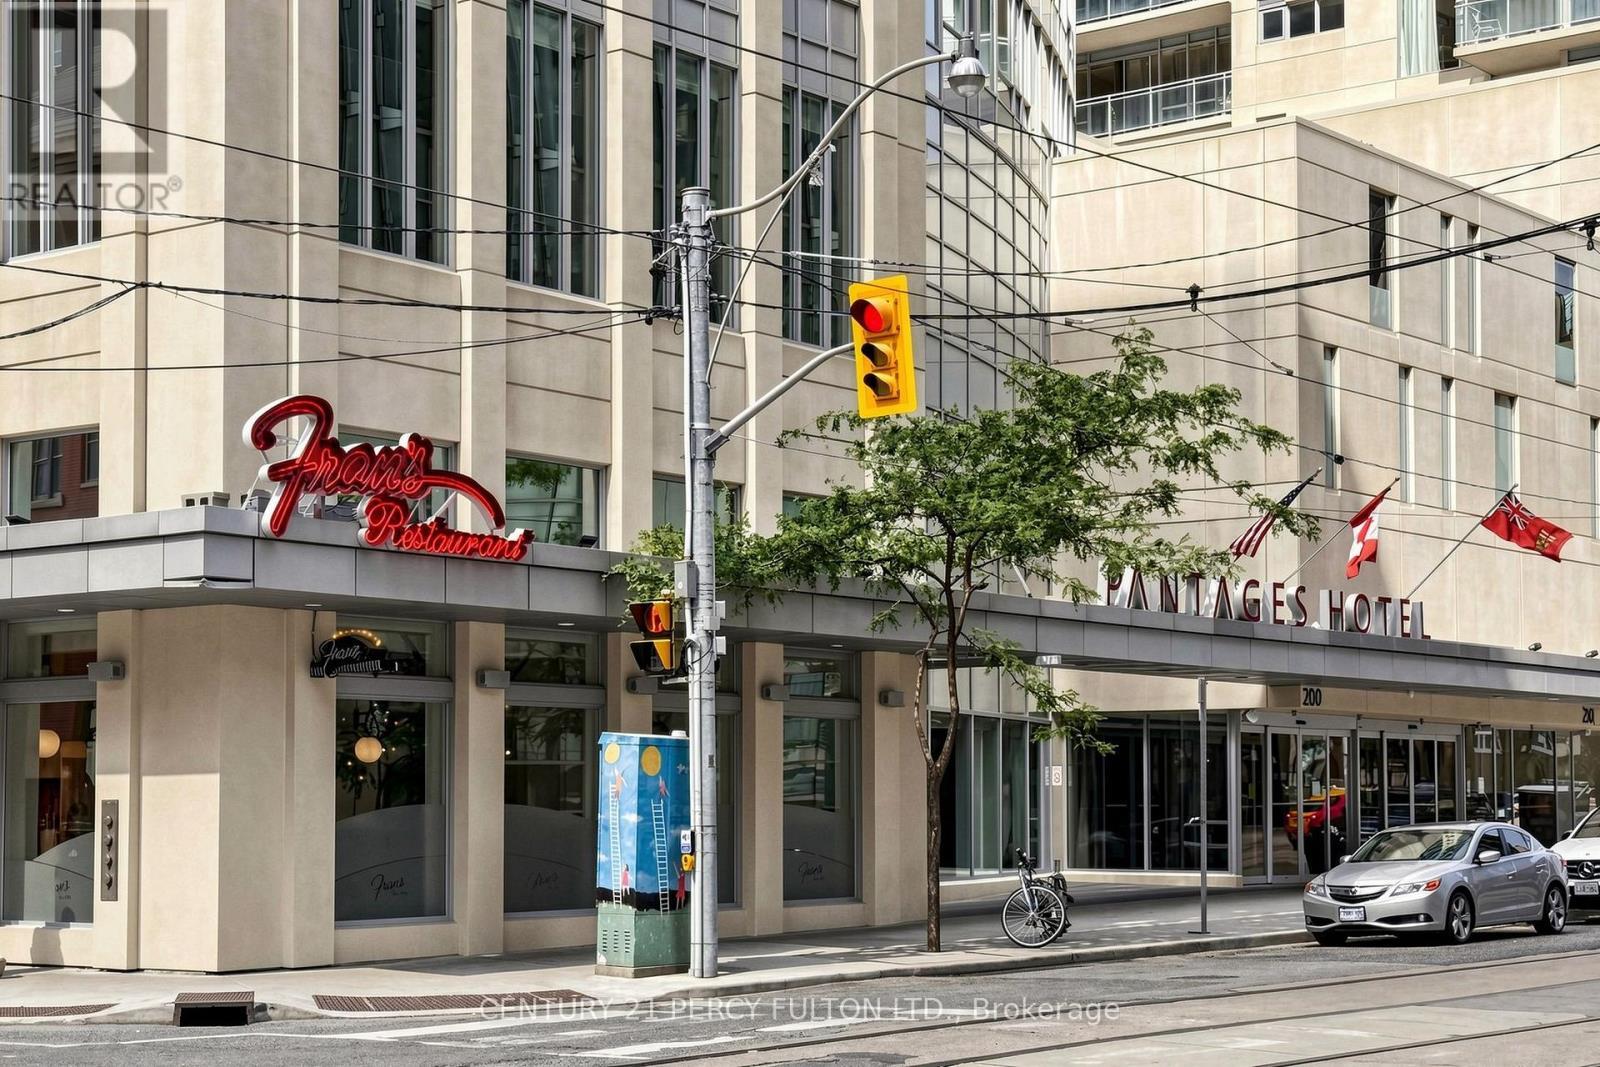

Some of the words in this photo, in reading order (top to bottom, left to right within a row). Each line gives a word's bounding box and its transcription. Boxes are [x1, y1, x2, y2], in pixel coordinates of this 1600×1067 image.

[243, 395, 505, 537] Fran's
[358, 497, 535, 561] Restaurant
[1106, 568, 1308, 627] PANTAGES
[1324, 589, 1432, 640] HOTEL
[1302, 687, 1322, 707] 200
